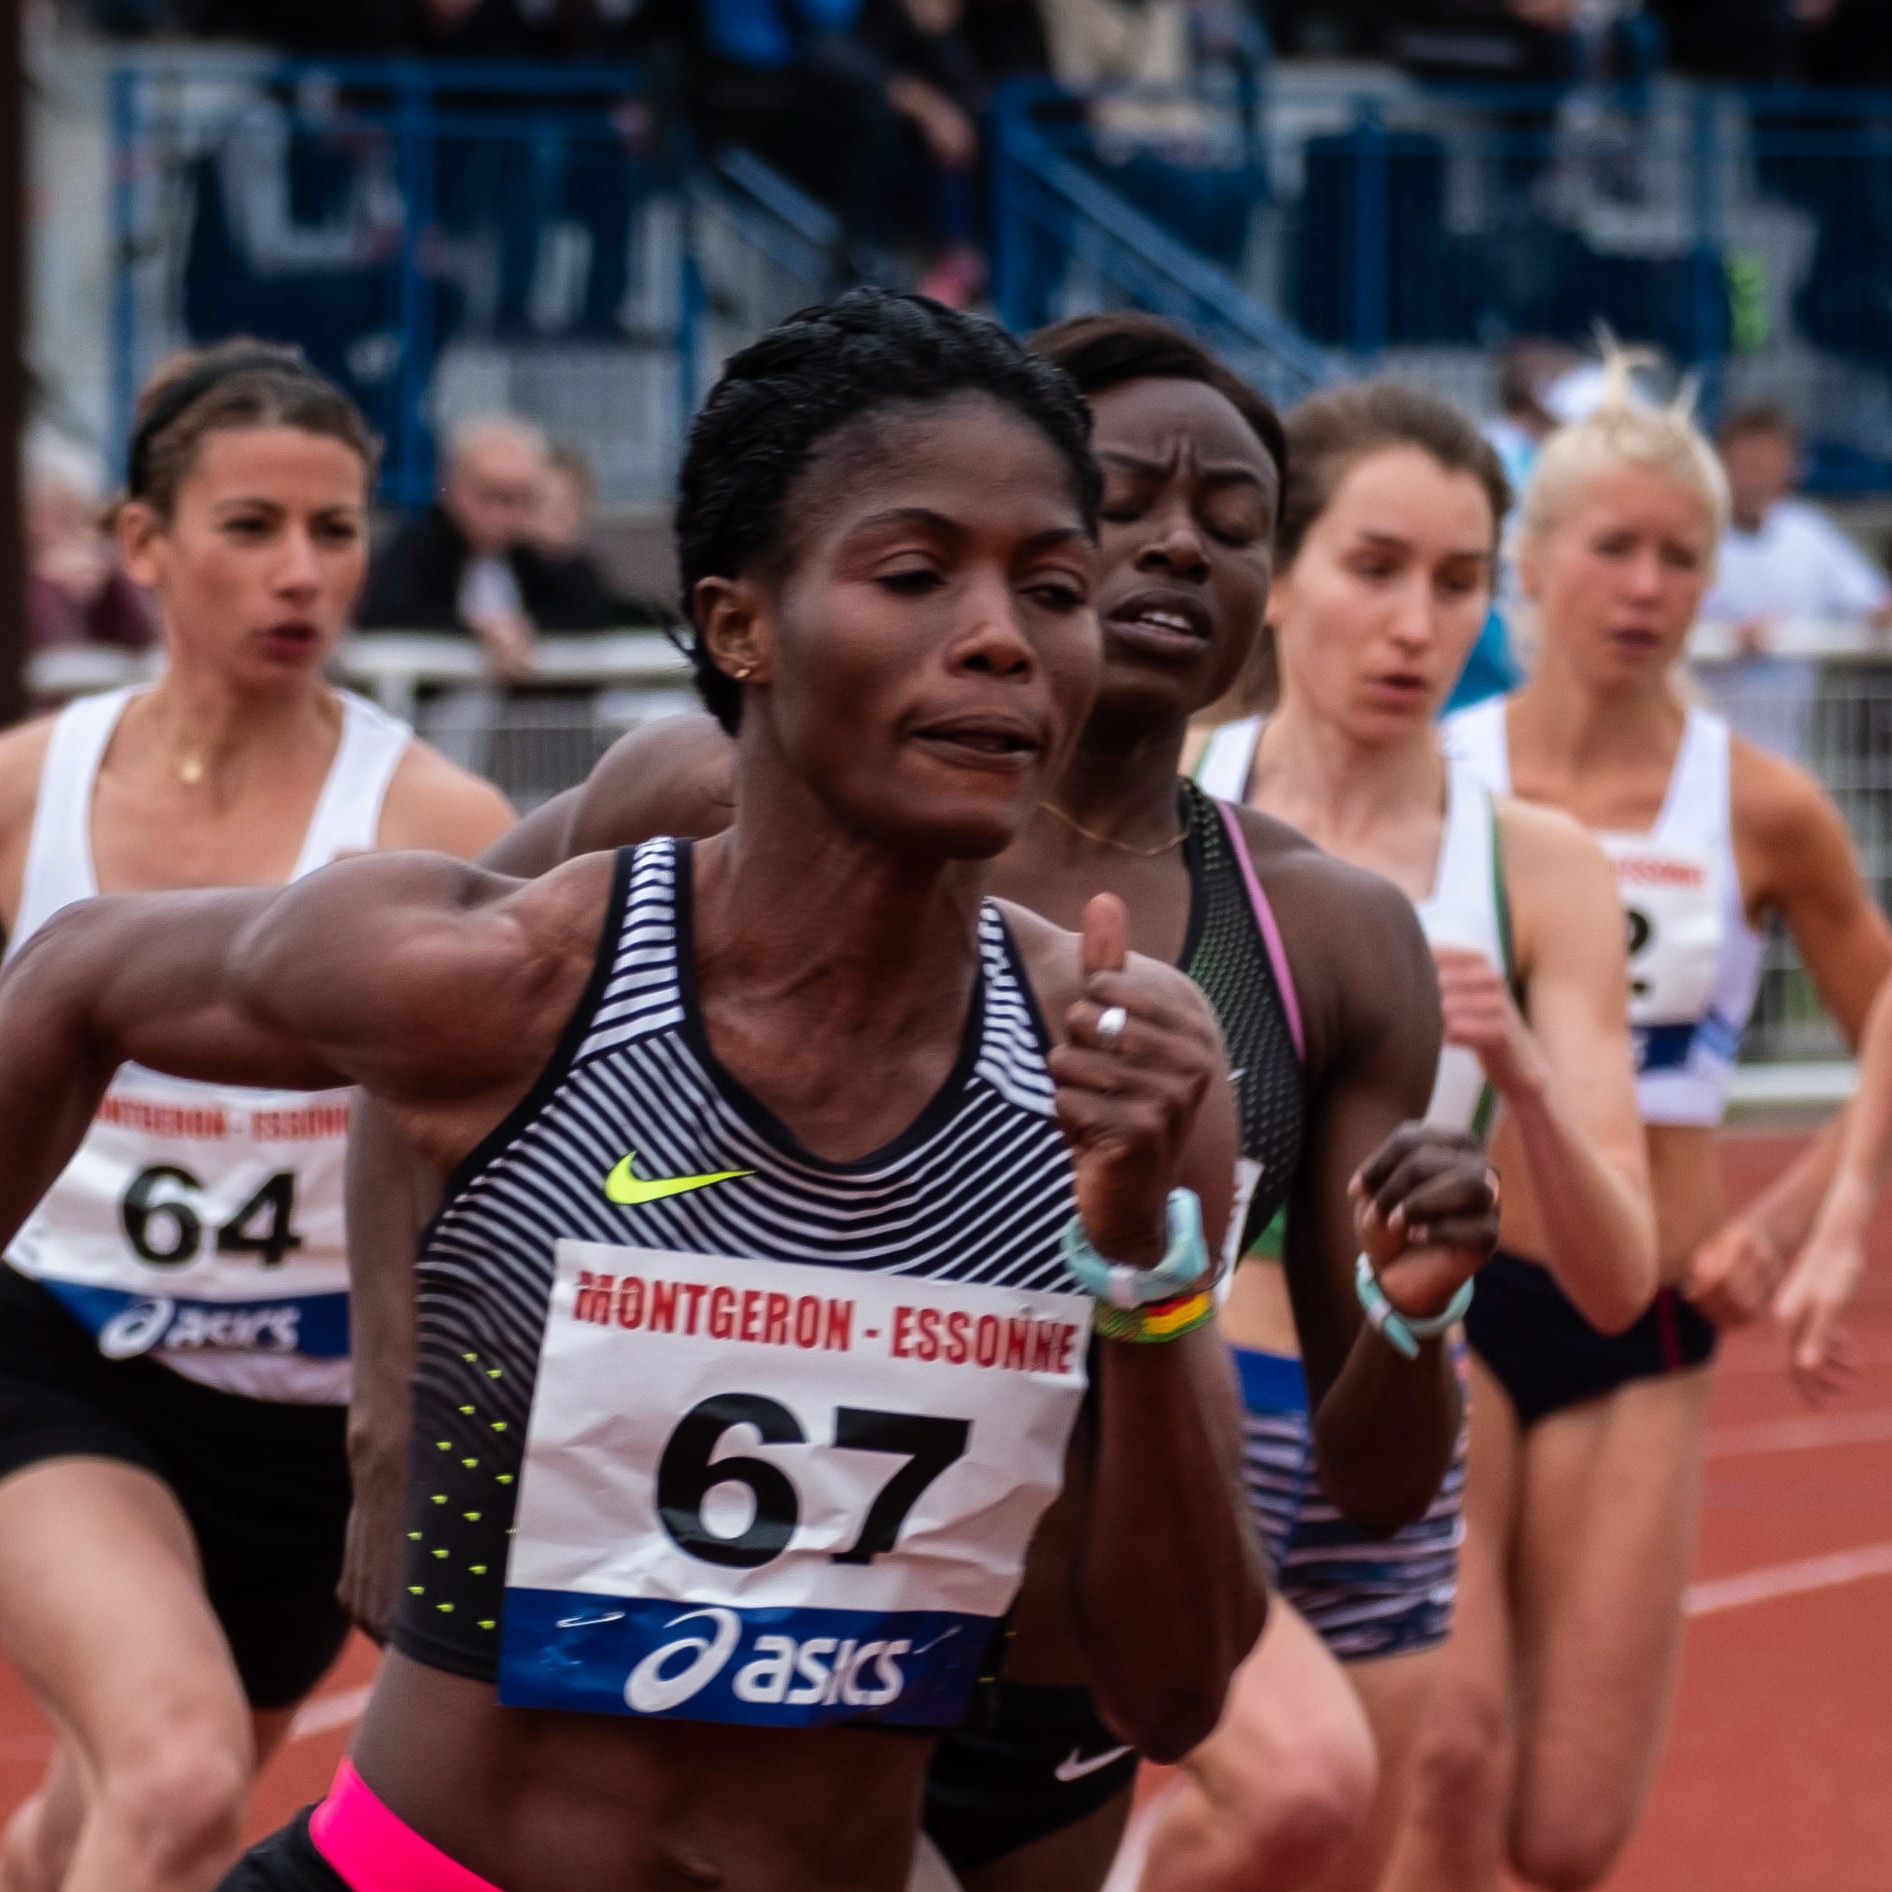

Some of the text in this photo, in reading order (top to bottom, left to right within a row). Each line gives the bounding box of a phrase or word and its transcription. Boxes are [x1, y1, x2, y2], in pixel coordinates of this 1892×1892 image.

[122, 1165, 302, 1266] 64
[574, 1270, 854, 1352] MONTGERON
[890, 1306, 1077, 1375] ESSONNE
[656, 1392, 974, 1569] 67
[732, 1635, 912, 1705] asics
